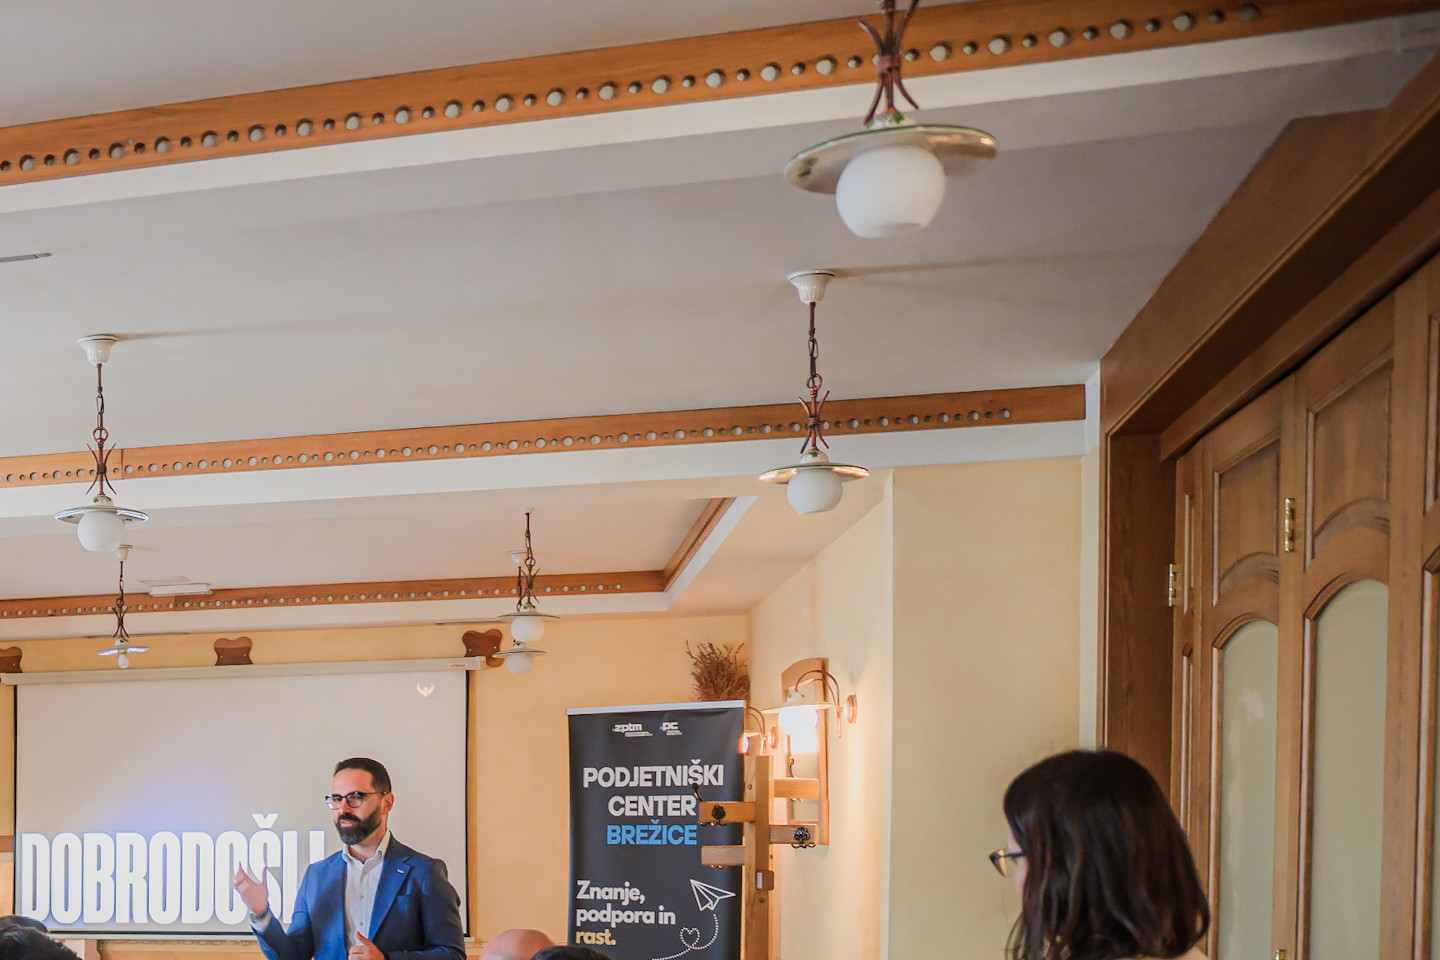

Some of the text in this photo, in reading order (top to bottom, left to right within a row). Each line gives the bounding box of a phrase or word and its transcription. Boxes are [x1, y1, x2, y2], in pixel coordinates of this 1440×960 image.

[583, 758, 724, 788] PODJETNIŠKI
[608, 795, 697, 817] CENTER
[606, 819, 698, 845] BREŽICE
[576, 880, 645, 905] Znanje,
[576, 903, 676, 928] podpora in
[576, 928, 616, 946] rast.
